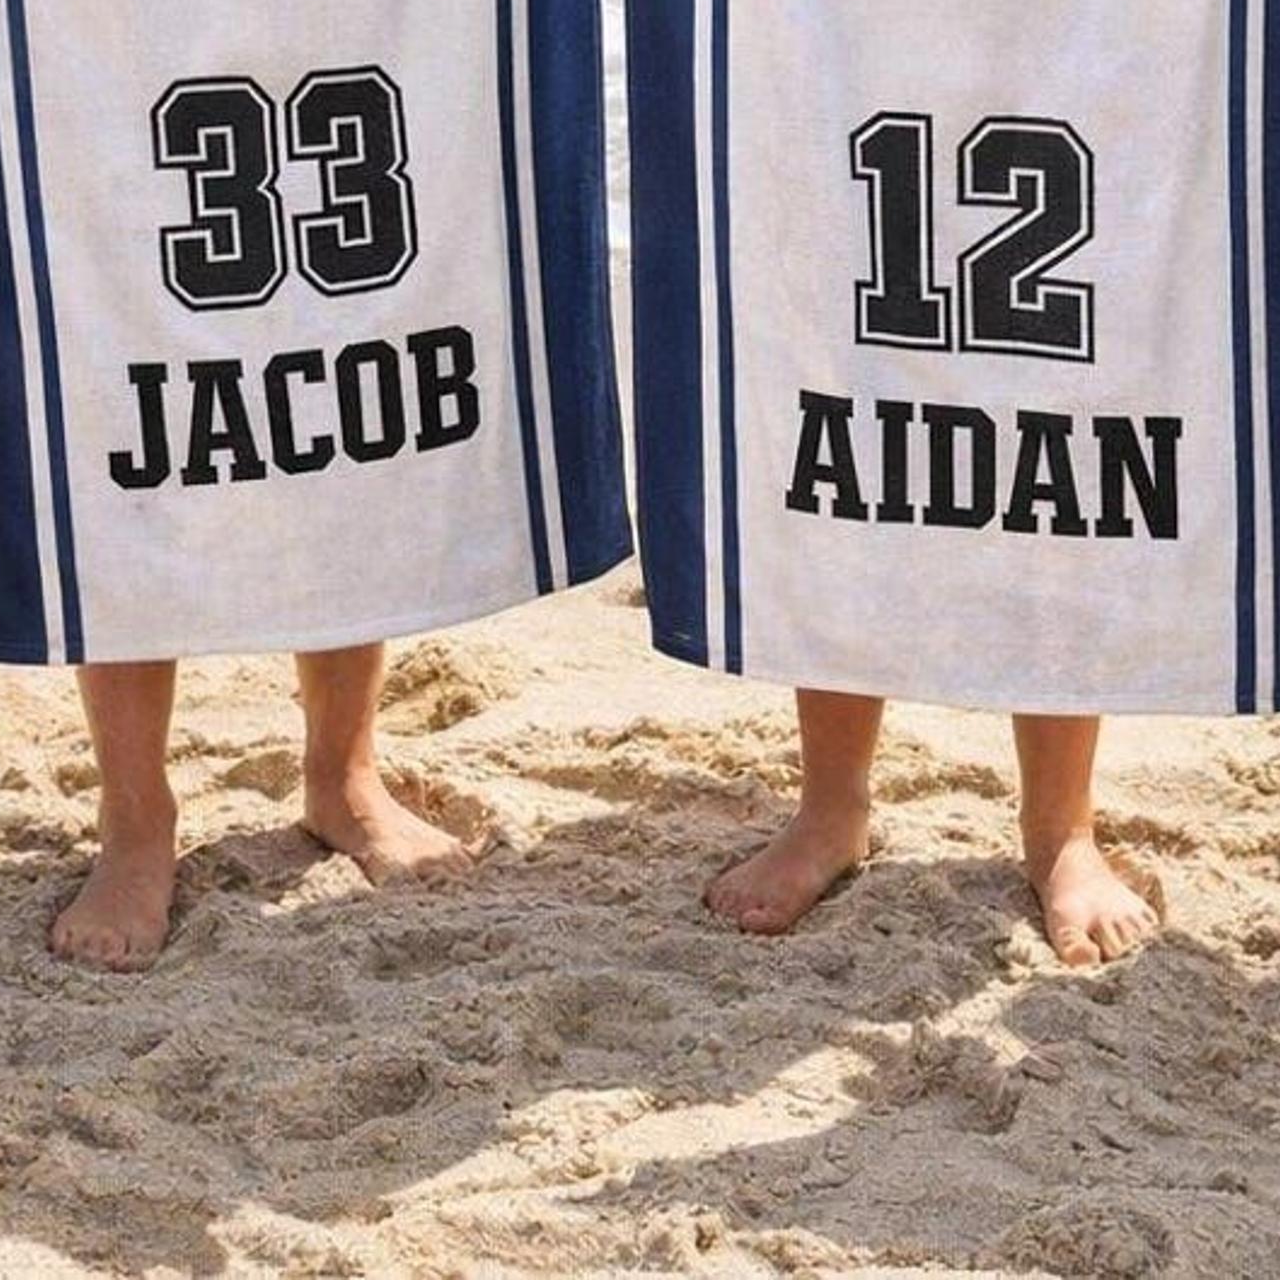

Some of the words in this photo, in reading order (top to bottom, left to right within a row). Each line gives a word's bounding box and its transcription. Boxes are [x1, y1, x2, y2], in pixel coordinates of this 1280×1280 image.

[151, 66, 418, 310] 33
[850, 113, 1094, 363] 12
[110, 324, 479, 488] JACOB
[787, 391, 1181, 539] AIDAN
